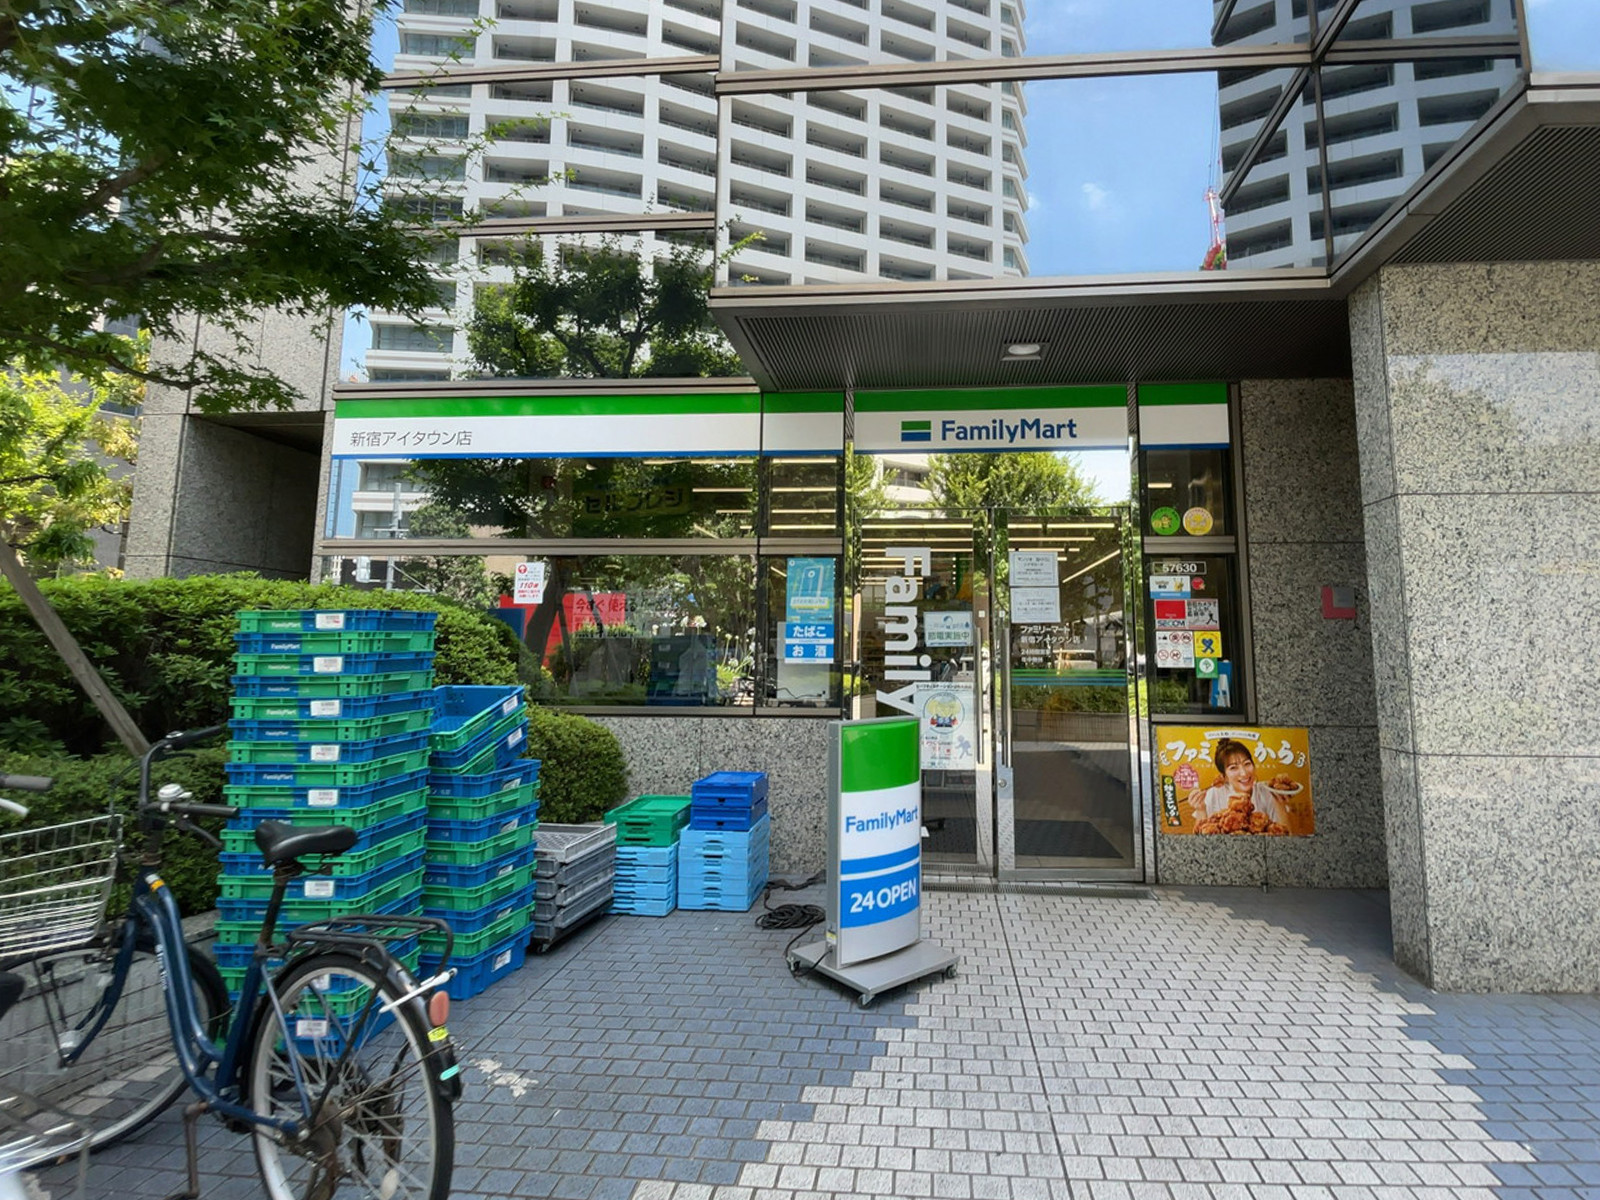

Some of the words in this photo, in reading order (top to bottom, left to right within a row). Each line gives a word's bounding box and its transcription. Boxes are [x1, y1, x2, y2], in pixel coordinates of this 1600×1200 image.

[941, 418, 1077, 443] FamilyMart
[350, 430, 472, 447] 新宿アイタウン店
[1162, 563, 1197, 573] 57630
[793, 626, 827, 638] たばこ
[876, 547, 932, 717] Family
[1021, 626, 1070, 634] ファミリーマート
[792, 644, 827, 658] お酒
[845, 805, 919, 833] FamilyMart
